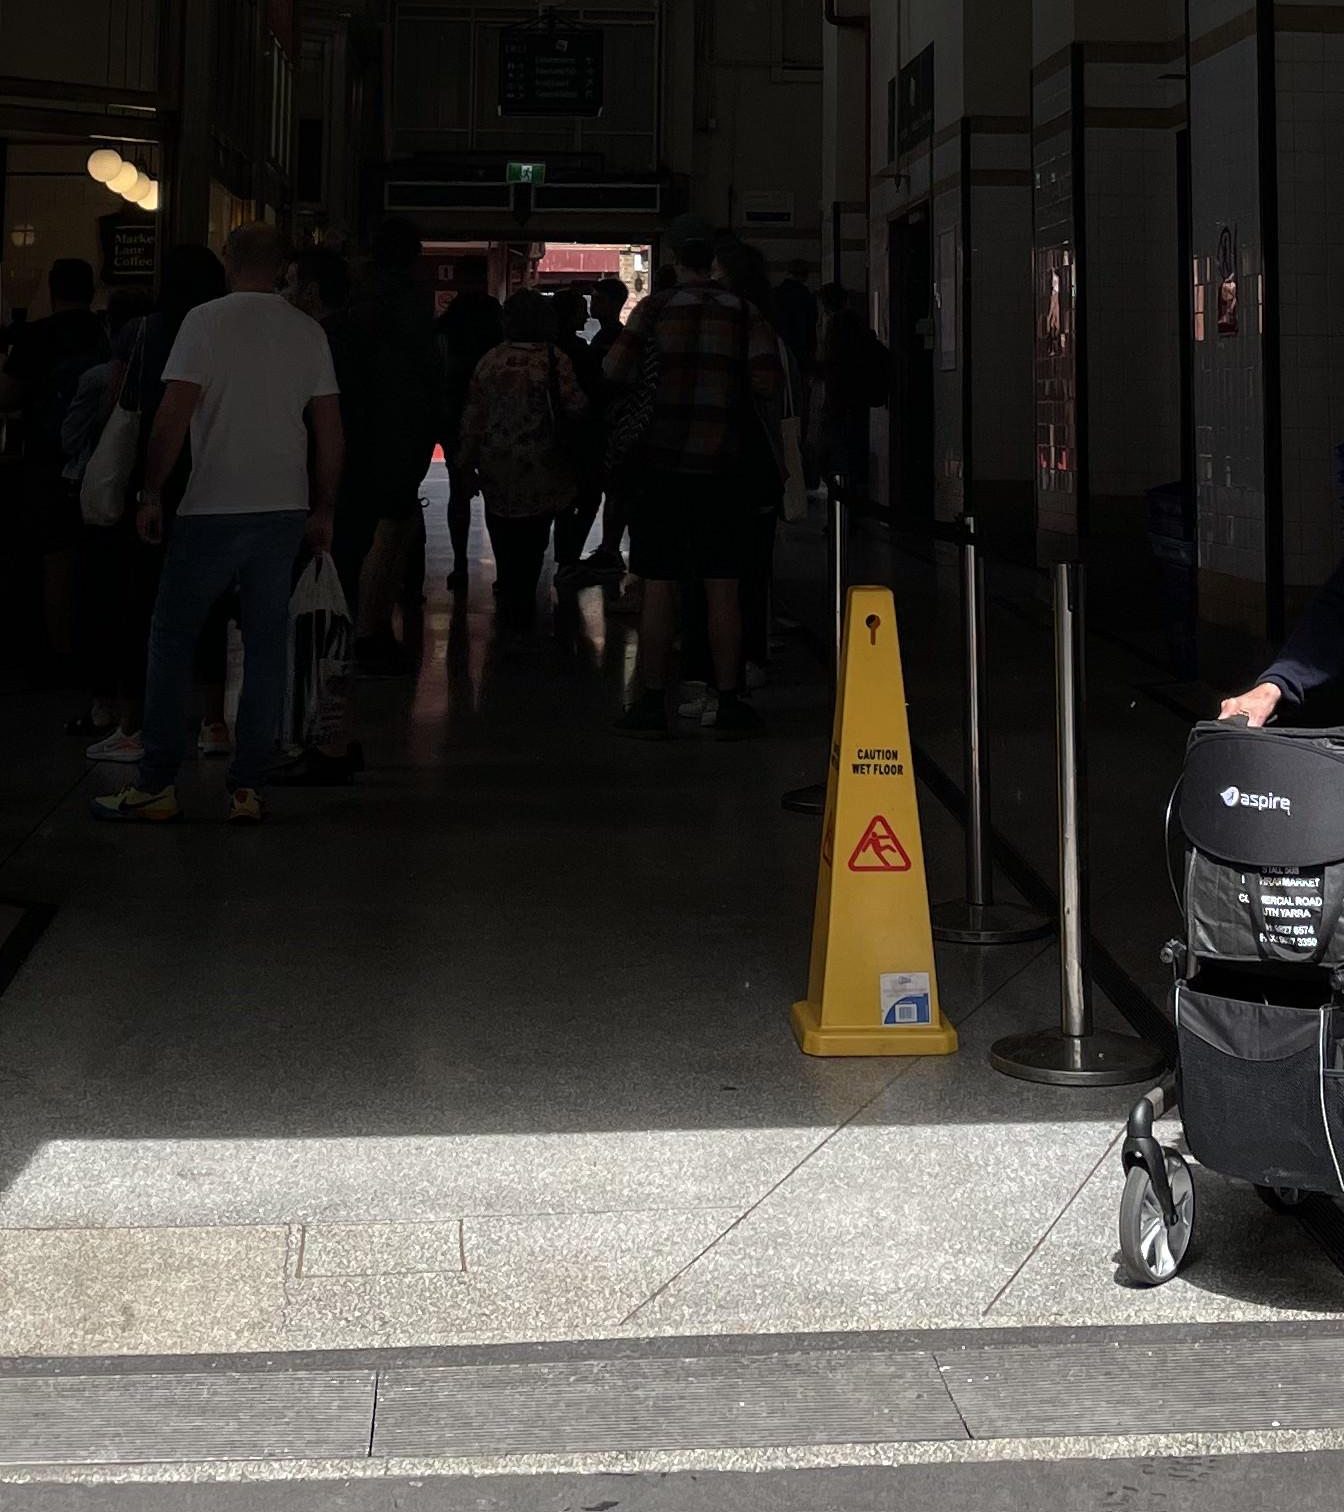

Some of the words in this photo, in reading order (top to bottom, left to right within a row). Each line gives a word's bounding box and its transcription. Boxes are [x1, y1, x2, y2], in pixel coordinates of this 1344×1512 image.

[114, 232, 155, 244] Marke
[113, 255, 153, 267] Coffee
[857, 749, 899, 760] CAUTION
[852, 763, 872, 775] WET
[873, 764, 904, 775] FLOOR
[1240, 792, 1291, 811] aspire
[1294, 896, 1322, 906] ROAD
[1280, 909, 1312, 918] YARRA
